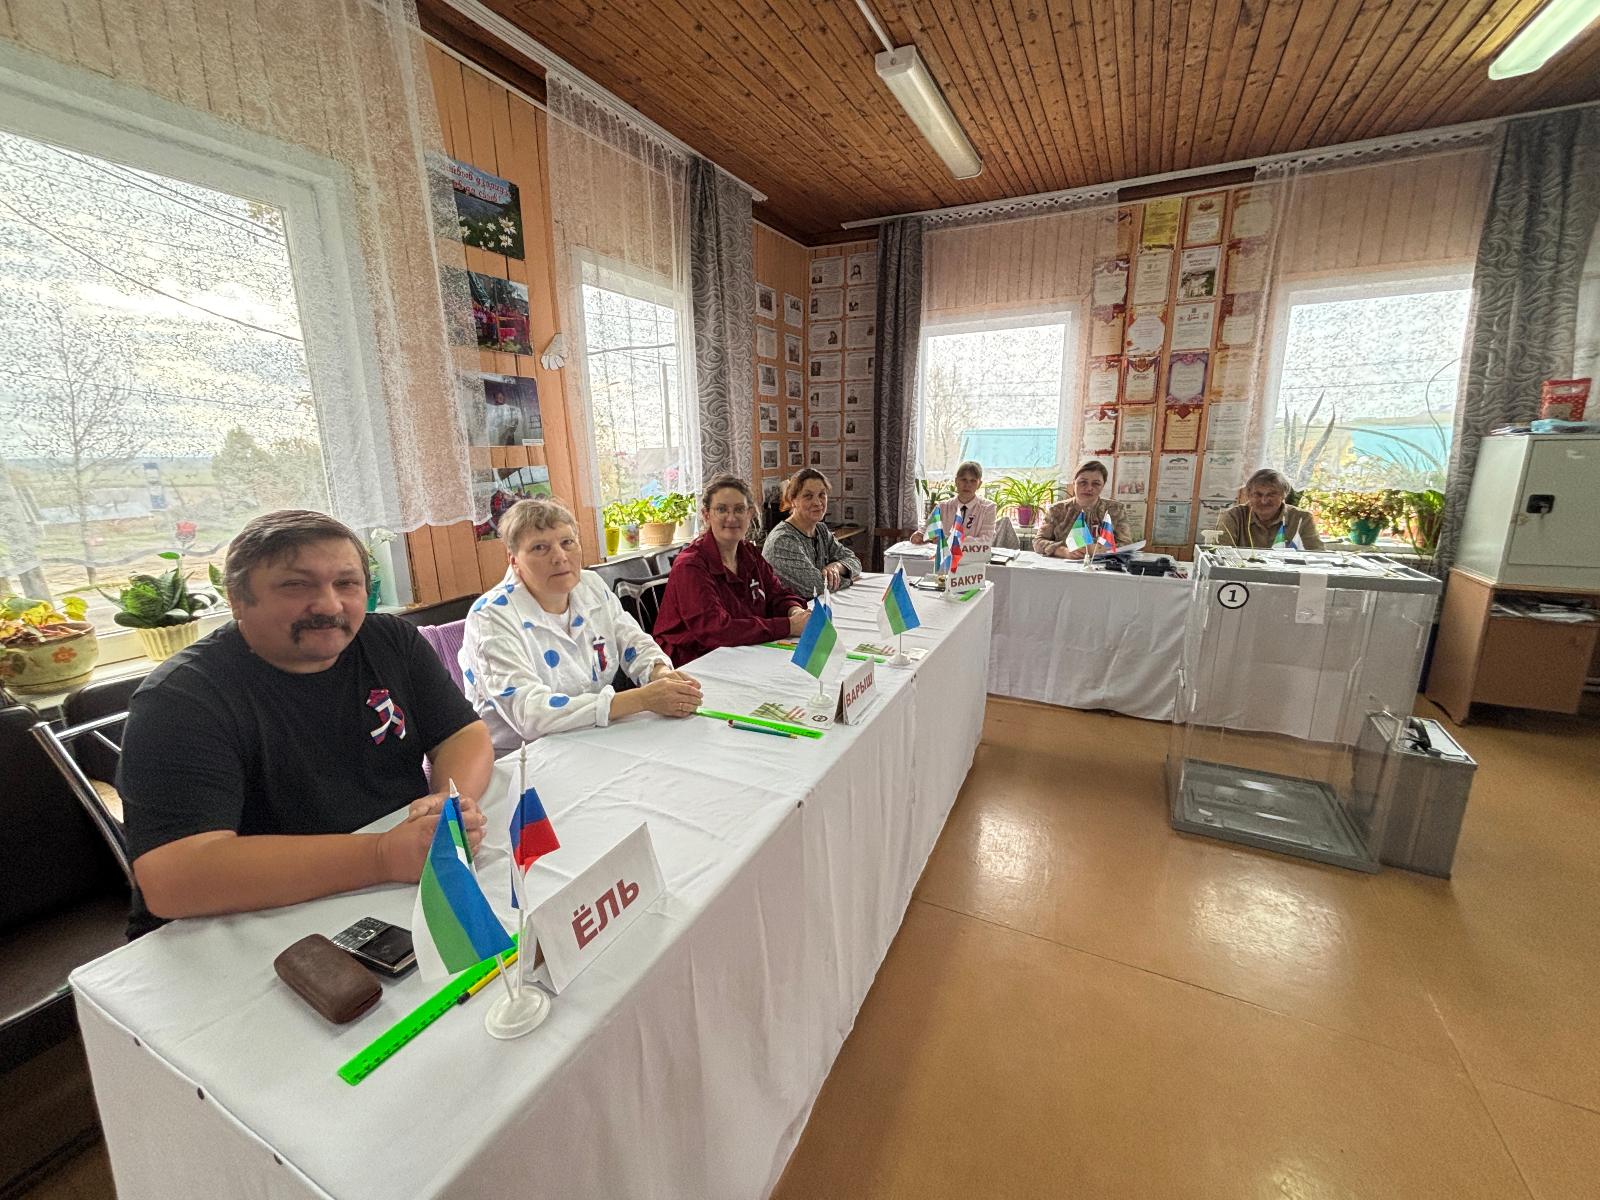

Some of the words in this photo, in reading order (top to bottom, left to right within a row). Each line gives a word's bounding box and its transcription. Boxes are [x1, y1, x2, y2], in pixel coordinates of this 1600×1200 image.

[961, 544, 989, 553] АКУР
[950, 573, 984, 588] БАКУР
[571, 879, 639, 950] ЁЛЬ
